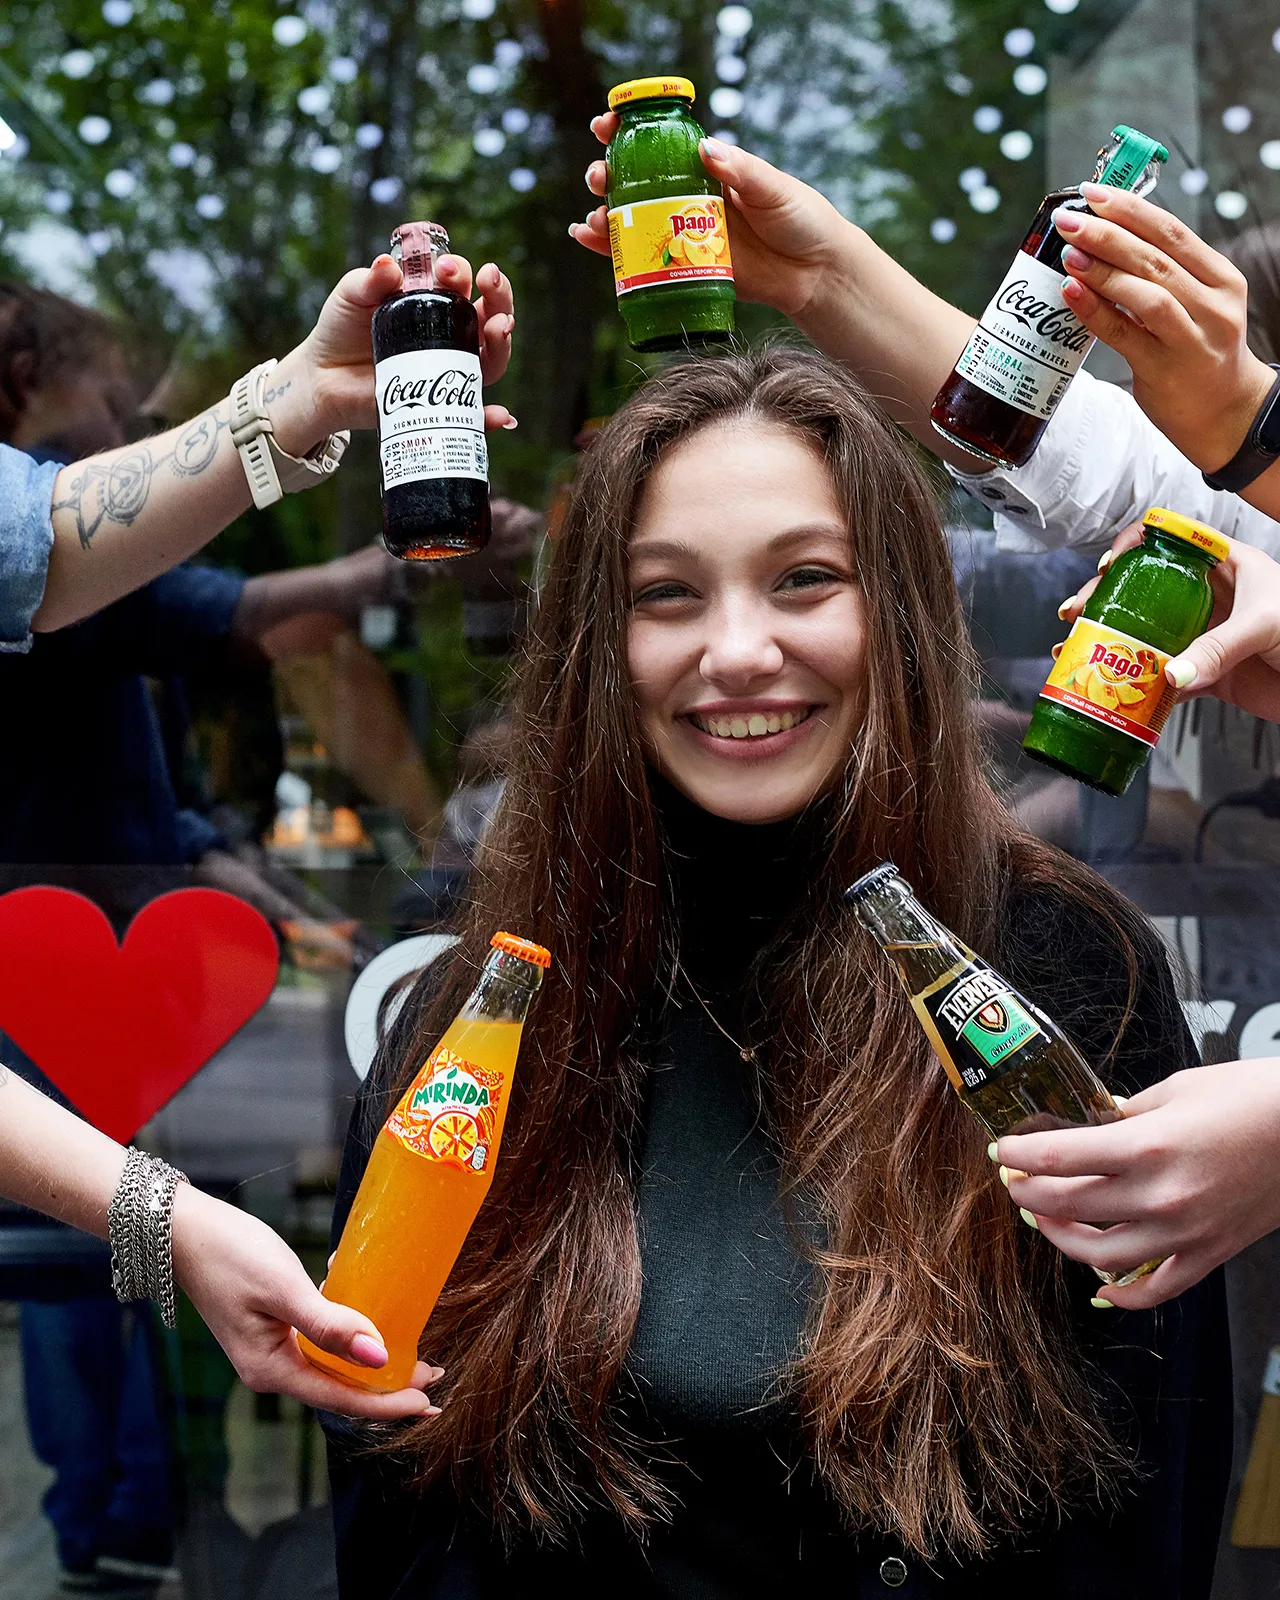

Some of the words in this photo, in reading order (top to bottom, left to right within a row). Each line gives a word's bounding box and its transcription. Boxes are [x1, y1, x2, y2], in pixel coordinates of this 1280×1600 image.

[966, 339, 989, 375] BATCH
[988, 345, 1023, 372] HERBAL
[993, 322, 1038, 353] SIGNATURE
[1039, 348, 1070, 369] MIXERS
[383, 370, 479, 416] Coca-Cola
[393, 416, 440, 430] SIGNATURE
[445, 416, 474, 425] MIXERS
[401, 436, 433, 450] SMOKY
[391, 442, 403, 479] BATCH
[412, 1081, 490, 1108] MIRINDA
